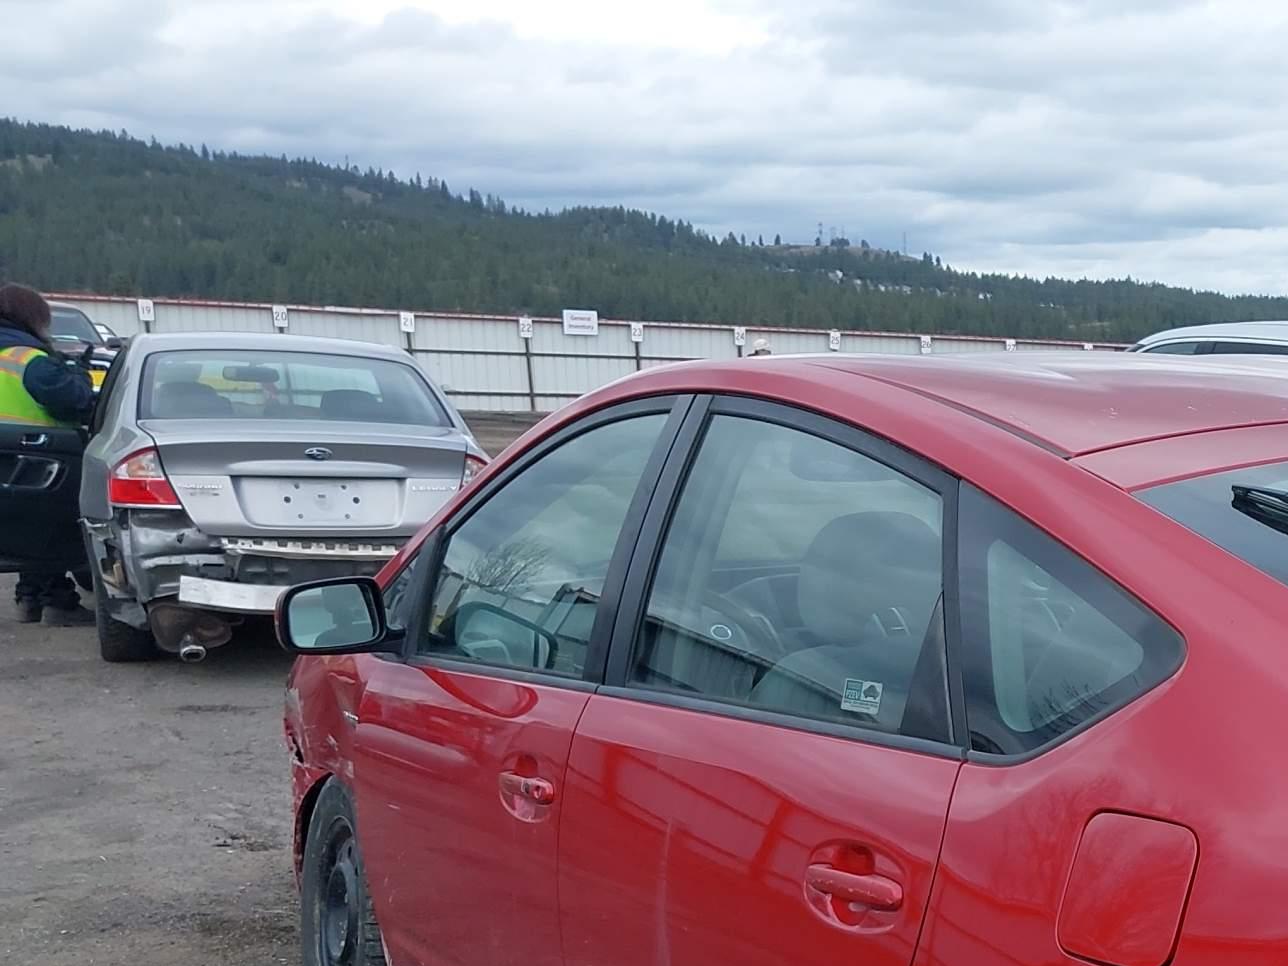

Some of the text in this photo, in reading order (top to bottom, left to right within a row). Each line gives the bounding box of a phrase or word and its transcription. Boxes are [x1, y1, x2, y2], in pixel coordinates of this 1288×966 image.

[141, 305, 152, 315] 19
[274, 311, 287, 321] 20
[402, 317, 414, 327] 21
[520, 323, 532, 333] 22
[632, 327, 642, 337] 23
[735, 332, 745, 340] 24
[831, 336, 840, 345] 25
[921, 341, 931, 349] 26
